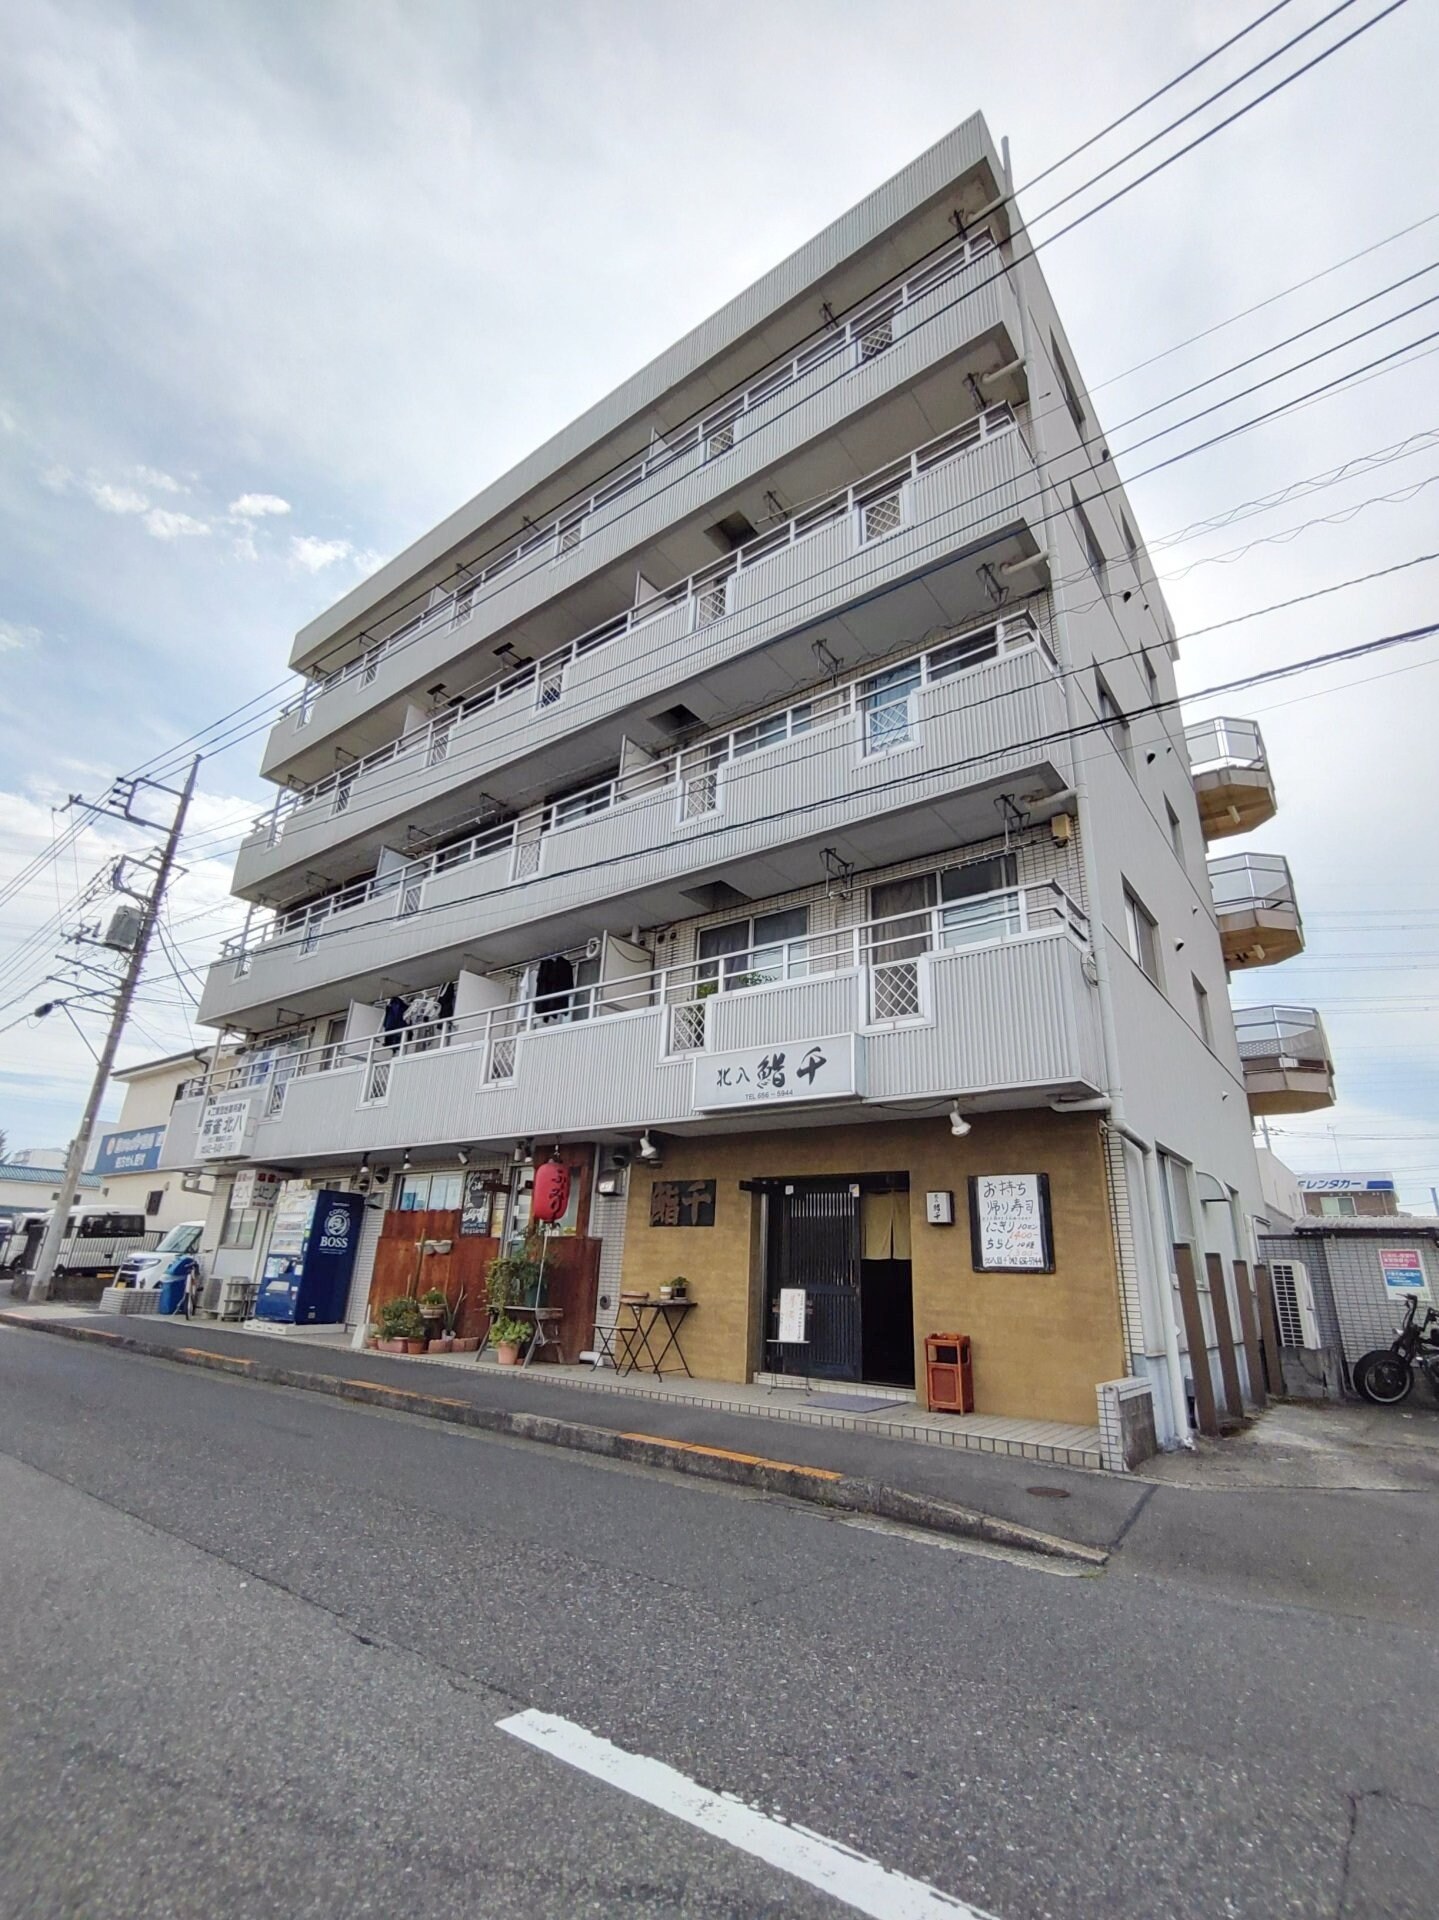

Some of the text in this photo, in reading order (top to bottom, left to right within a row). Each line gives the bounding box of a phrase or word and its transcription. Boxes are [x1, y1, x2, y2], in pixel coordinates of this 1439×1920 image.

[983, 1180, 1027, 1198] お持ち
[987, 1199, 1034, 1217] 帰り寿司
[986, 1221, 1015, 1234] にぎり
[320, 1236, 348, 1248] BOSS
[986, 1237, 1014, 1250] ちらし
